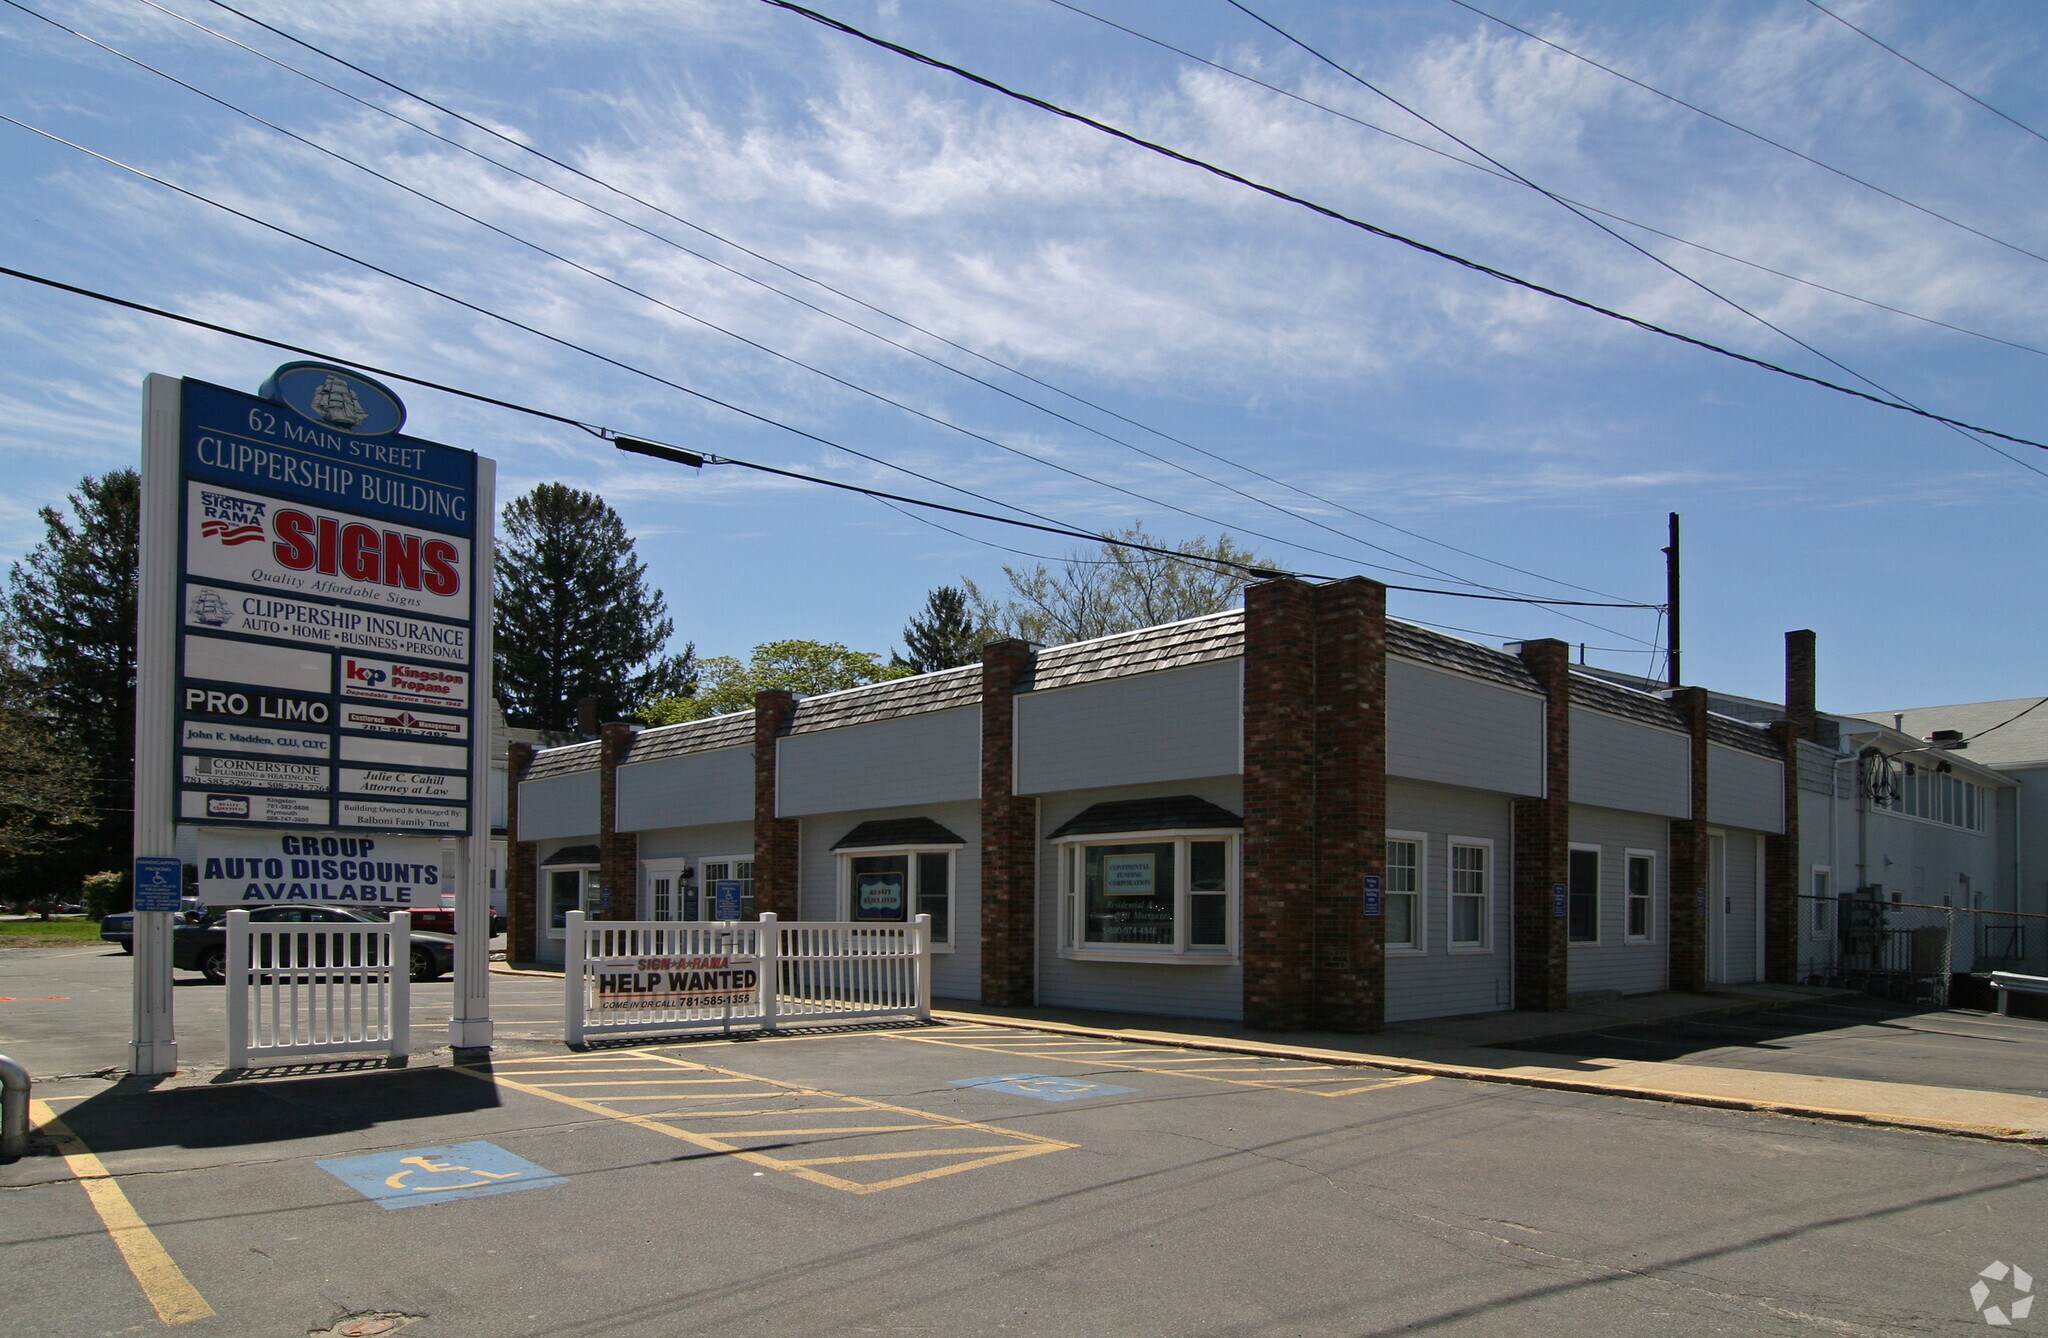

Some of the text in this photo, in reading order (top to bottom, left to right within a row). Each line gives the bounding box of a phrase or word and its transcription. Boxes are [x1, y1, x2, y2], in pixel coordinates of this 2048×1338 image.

[249, 408, 425, 471] 62 MAIN STREET
[198, 437, 466, 522] CLIPPERSHIP BUILDING
[204, 506, 261, 526] RAMA
[272, 508, 460, 597] SIGNS
[251, 569, 421, 607] Quality Affordable Signs
[243, 598, 463, 646] CLIPPERSHIP INSURANCE
[242, 618, 464, 659] AUTO HOME BUSINESS PERSONAL
[392, 664, 463, 684] Kingston
[392, 677, 450, 694] Propane
[186, 688, 329, 723] PRO LIMO
[346, 689, 388, 699] Dependable
[392, 695, 419, 703] Service
[418, 721, 457, 731] Management
[187, 729, 327, 750] John K. Madden, CLU, CLTC
[213, 759, 320, 776] CORNERSTONE
[215, 769, 259, 778] PLUMBING
[267, 773, 304, 782] HEATING
[363, 771, 445, 785] Julie C. Cahill
[360, 782, 449, 796] Attorney at Law
[266, 797, 296, 805] Kingston
[344, 804, 377, 813] Building
[380, 806, 405, 814] Owned
[415, 808, 449, 817] Managed
[266, 809, 298, 817] Plymouth
[357, 815, 450, 828] Balboni Family Trust
[281, 835, 375, 858] GROUP
[204, 858, 438, 885] AUTO DISCOUNTS
[242, 882, 412, 903] AVAILABLE
[600, 970, 757, 994] HELP WANTED
[602, 1001, 629, 1009] COME
[630, 1001, 639, 1009] IN
[655, 1000, 677, 1008] CALL
[679, 994, 750, 1007] 781-585-1355
